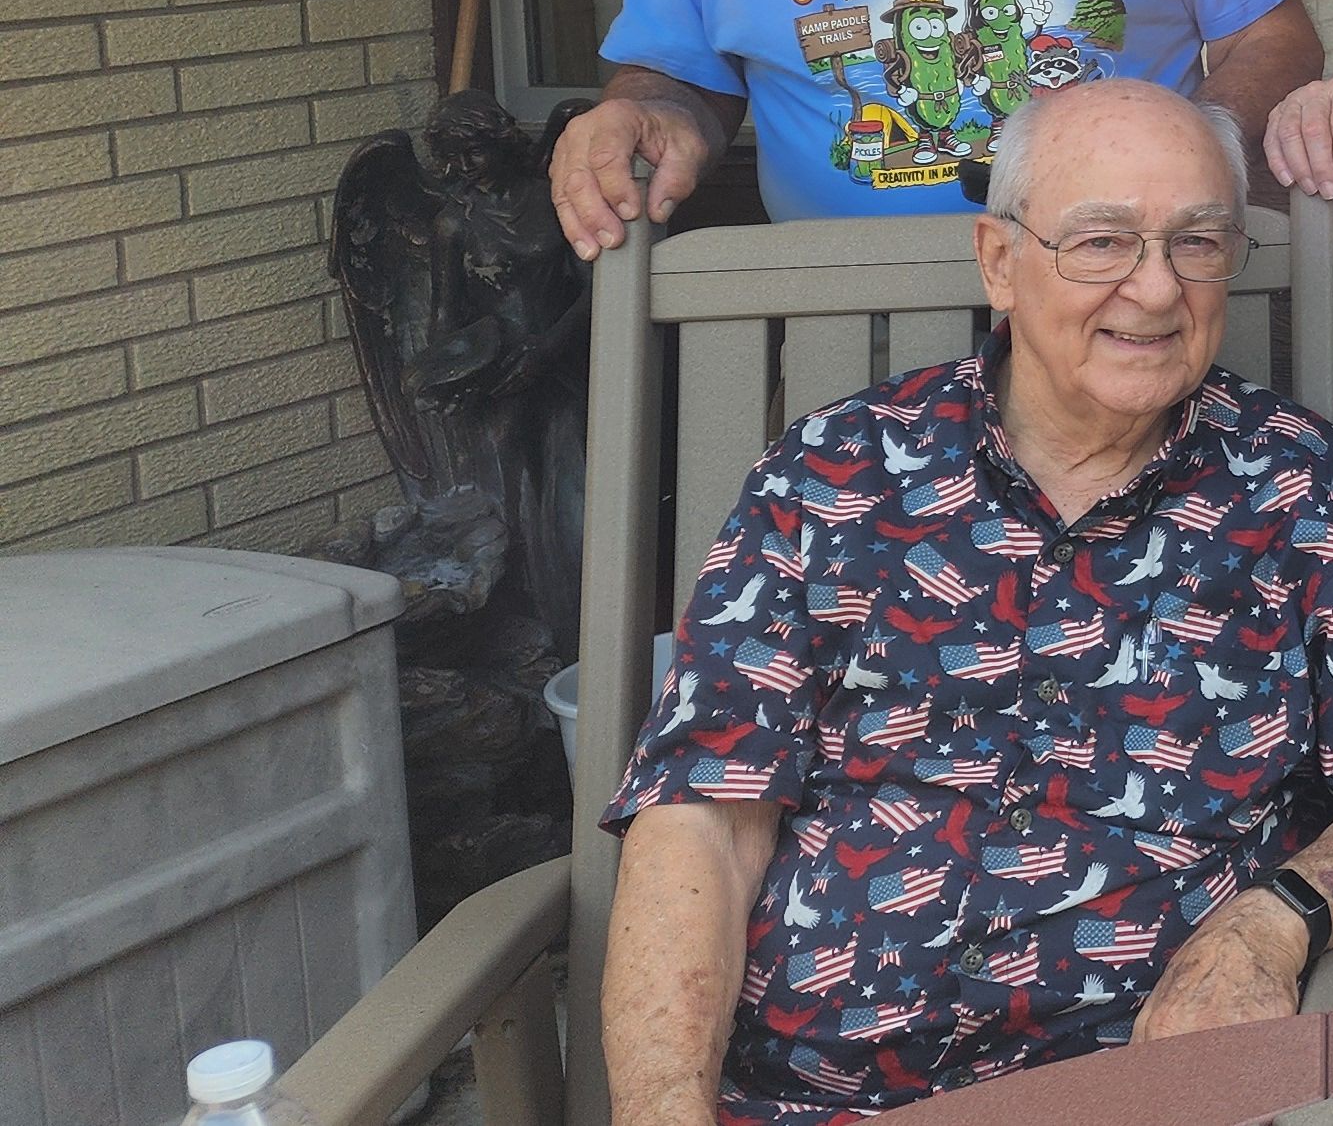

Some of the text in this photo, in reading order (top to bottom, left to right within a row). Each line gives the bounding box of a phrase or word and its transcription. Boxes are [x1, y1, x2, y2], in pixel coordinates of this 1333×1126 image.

[801, 15, 868, 36] KAMP PADDLE
[819, 30, 853, 45] TRAILS
[854, 147, 882, 157] PICKLES
[878, 170, 925, 184] CREATIVITY
[929, 168, 939, 180] IN
